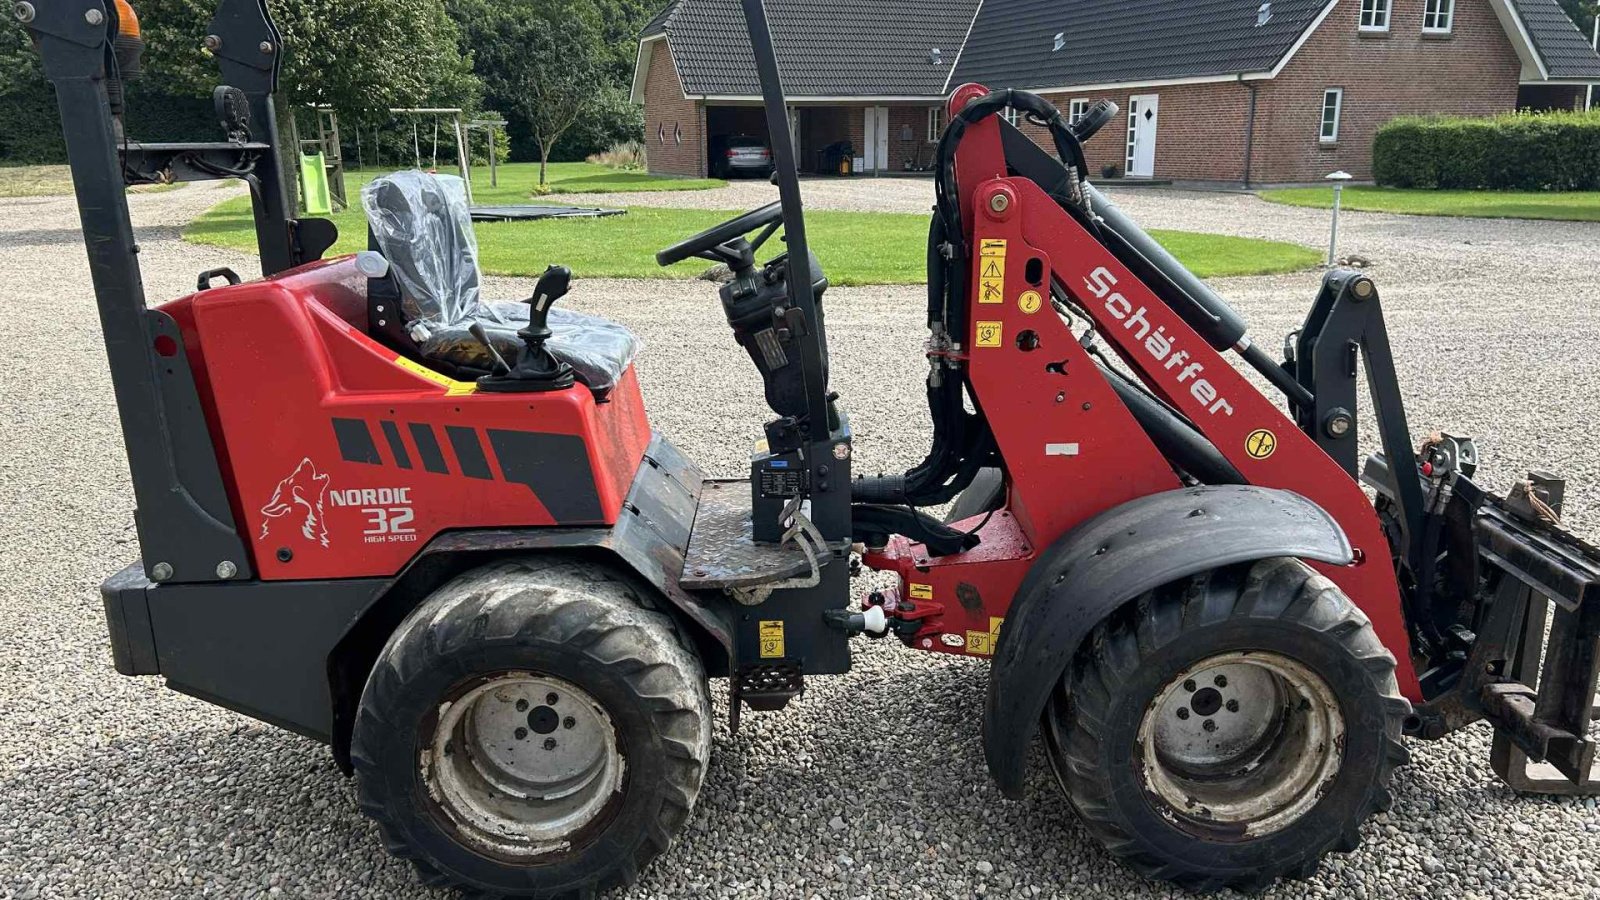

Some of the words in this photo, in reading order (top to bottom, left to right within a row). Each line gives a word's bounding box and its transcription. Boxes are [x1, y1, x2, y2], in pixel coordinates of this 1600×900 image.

[1083, 266, 1233, 416] Schäffer
[329, 487, 412, 507] NORDIC
[361, 507, 416, 534] 32
[364, 535, 386, 543] HIGH
[388, 534, 417, 542] SPEED
